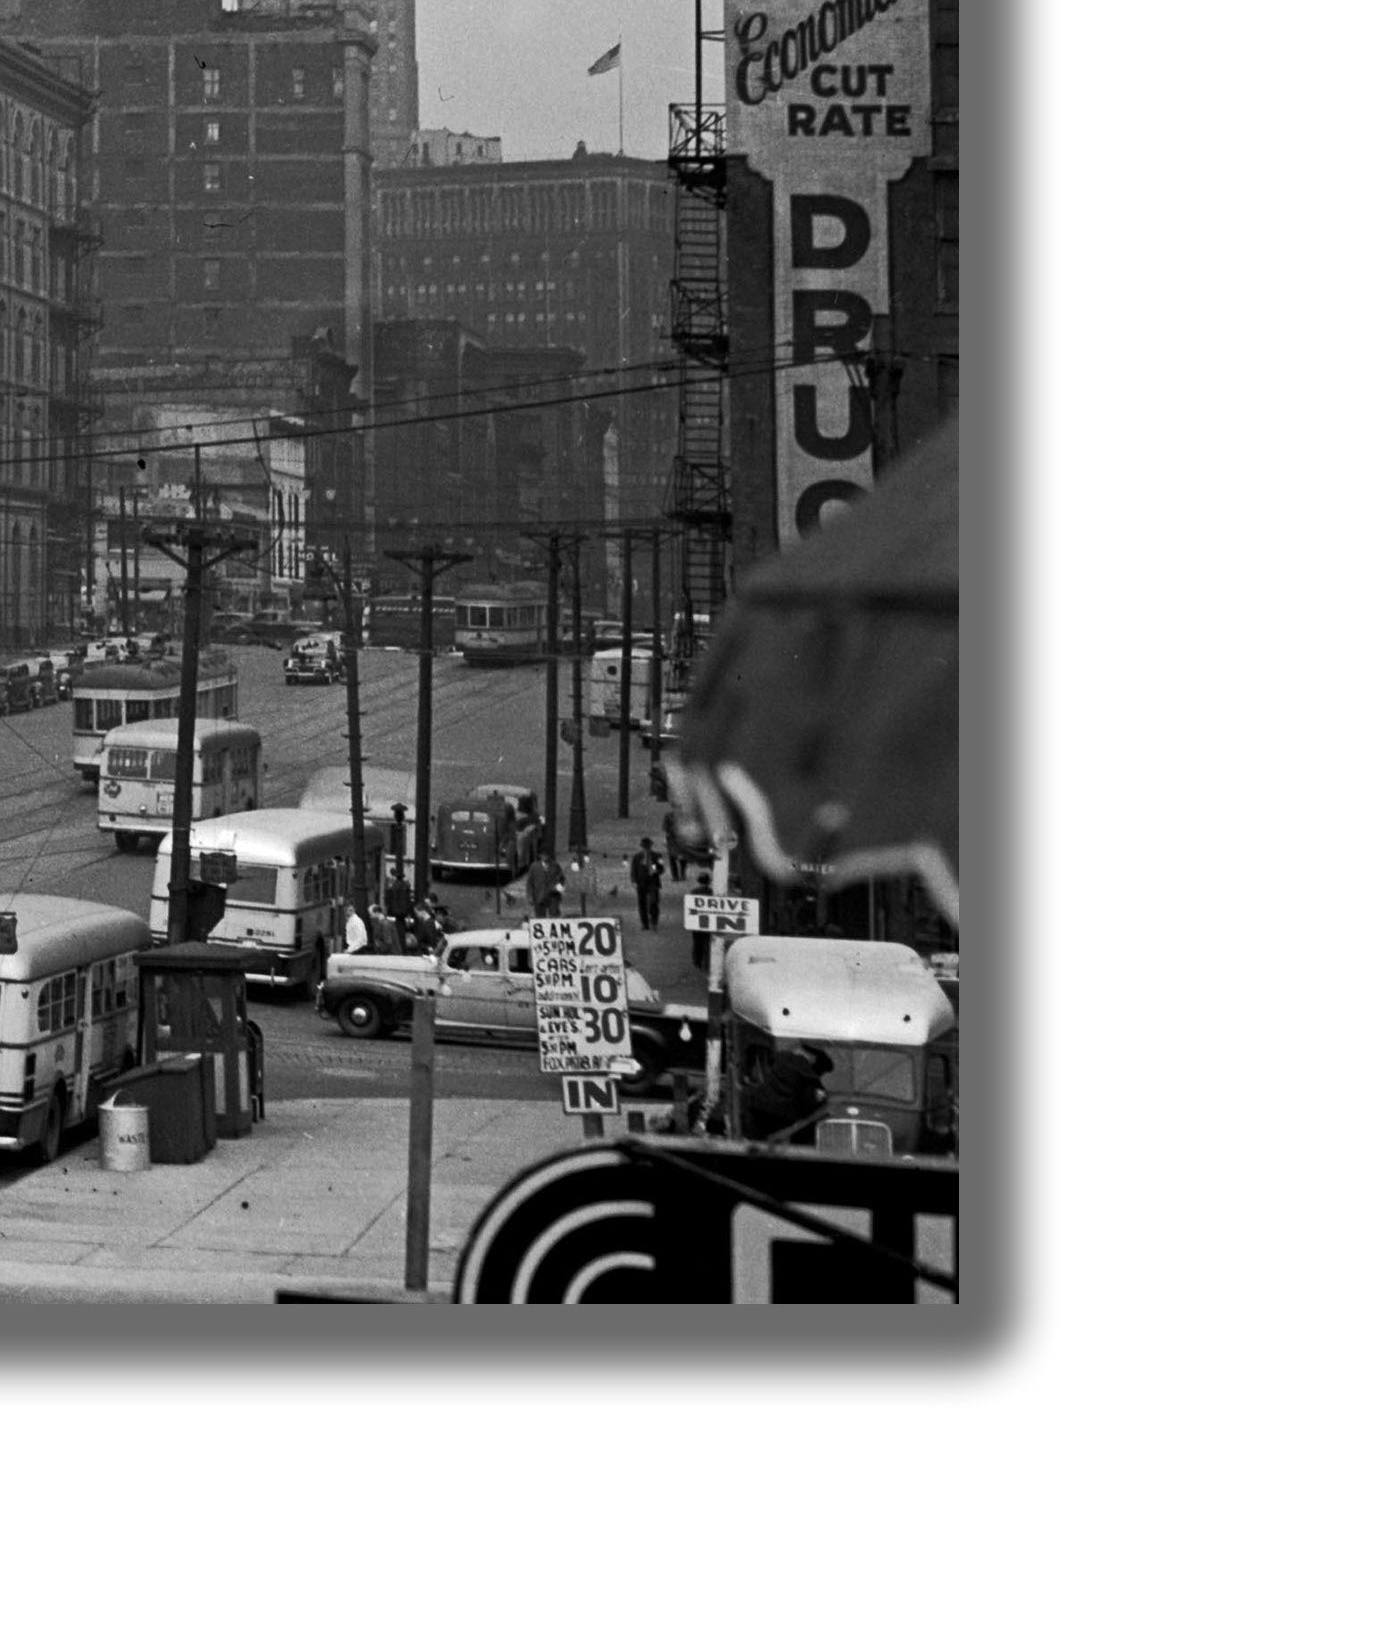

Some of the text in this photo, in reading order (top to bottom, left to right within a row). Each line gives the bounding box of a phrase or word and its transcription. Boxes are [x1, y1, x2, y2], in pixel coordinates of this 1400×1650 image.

[810, 64, 895, 98] CUT
[787, 104, 912, 137] RATE
[694, 897, 751, 912] DRIVE
[533, 923, 545, 940] 8
[698, 914, 746, 932] IN
[536, 958, 578, 973] CARS
[567, 1079, 614, 1109] IN
